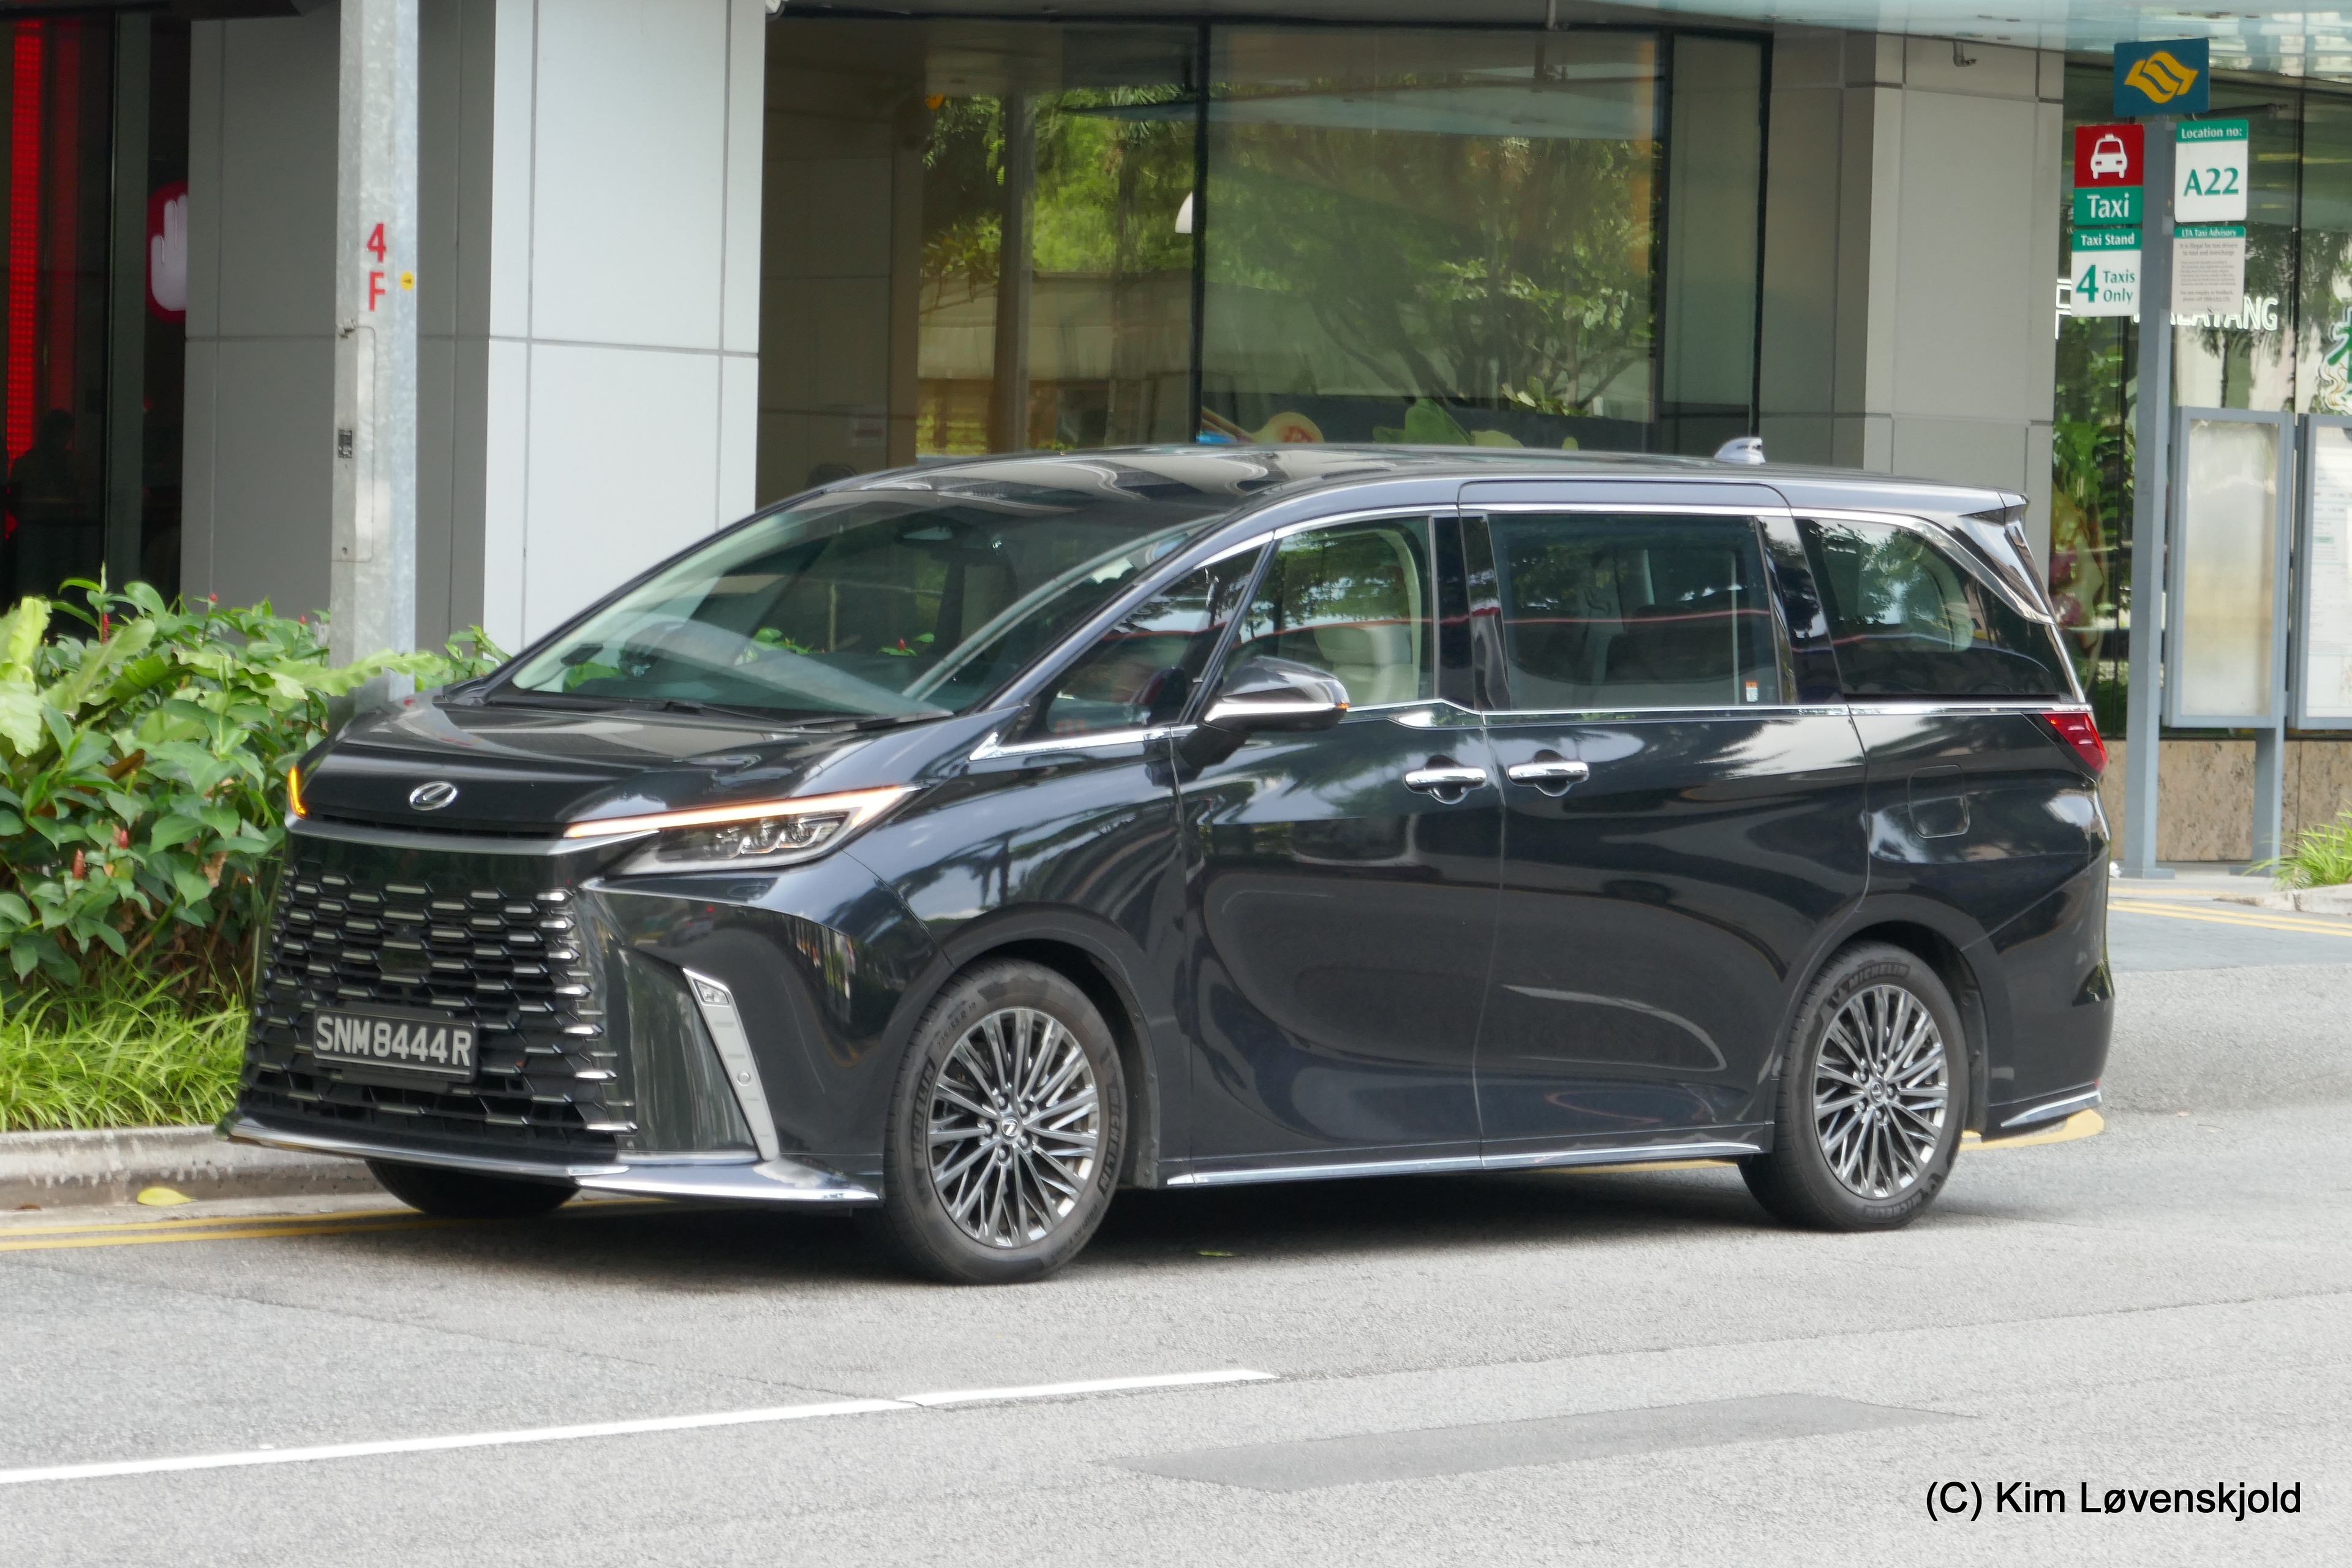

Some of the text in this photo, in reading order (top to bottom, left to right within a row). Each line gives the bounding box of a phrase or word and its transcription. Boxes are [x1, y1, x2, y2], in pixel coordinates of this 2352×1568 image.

[2181, 126, 2242, 139] Location no:
[2184, 167, 2239, 197] A22
[2086, 192, 2130, 218] Taxi
[367, 222, 386, 262] 4
[2081, 232, 2135, 246] Taxi Stand
[2195, 228, 2208, 237] Taxi
[2076, 265, 2099, 303] 4
[2103, 269, 2135, 284] Taxis
[369, 271, 386, 312] F
[2103, 287, 2133, 305] Only
[316, 1015, 472, 1066] SNM8444R
